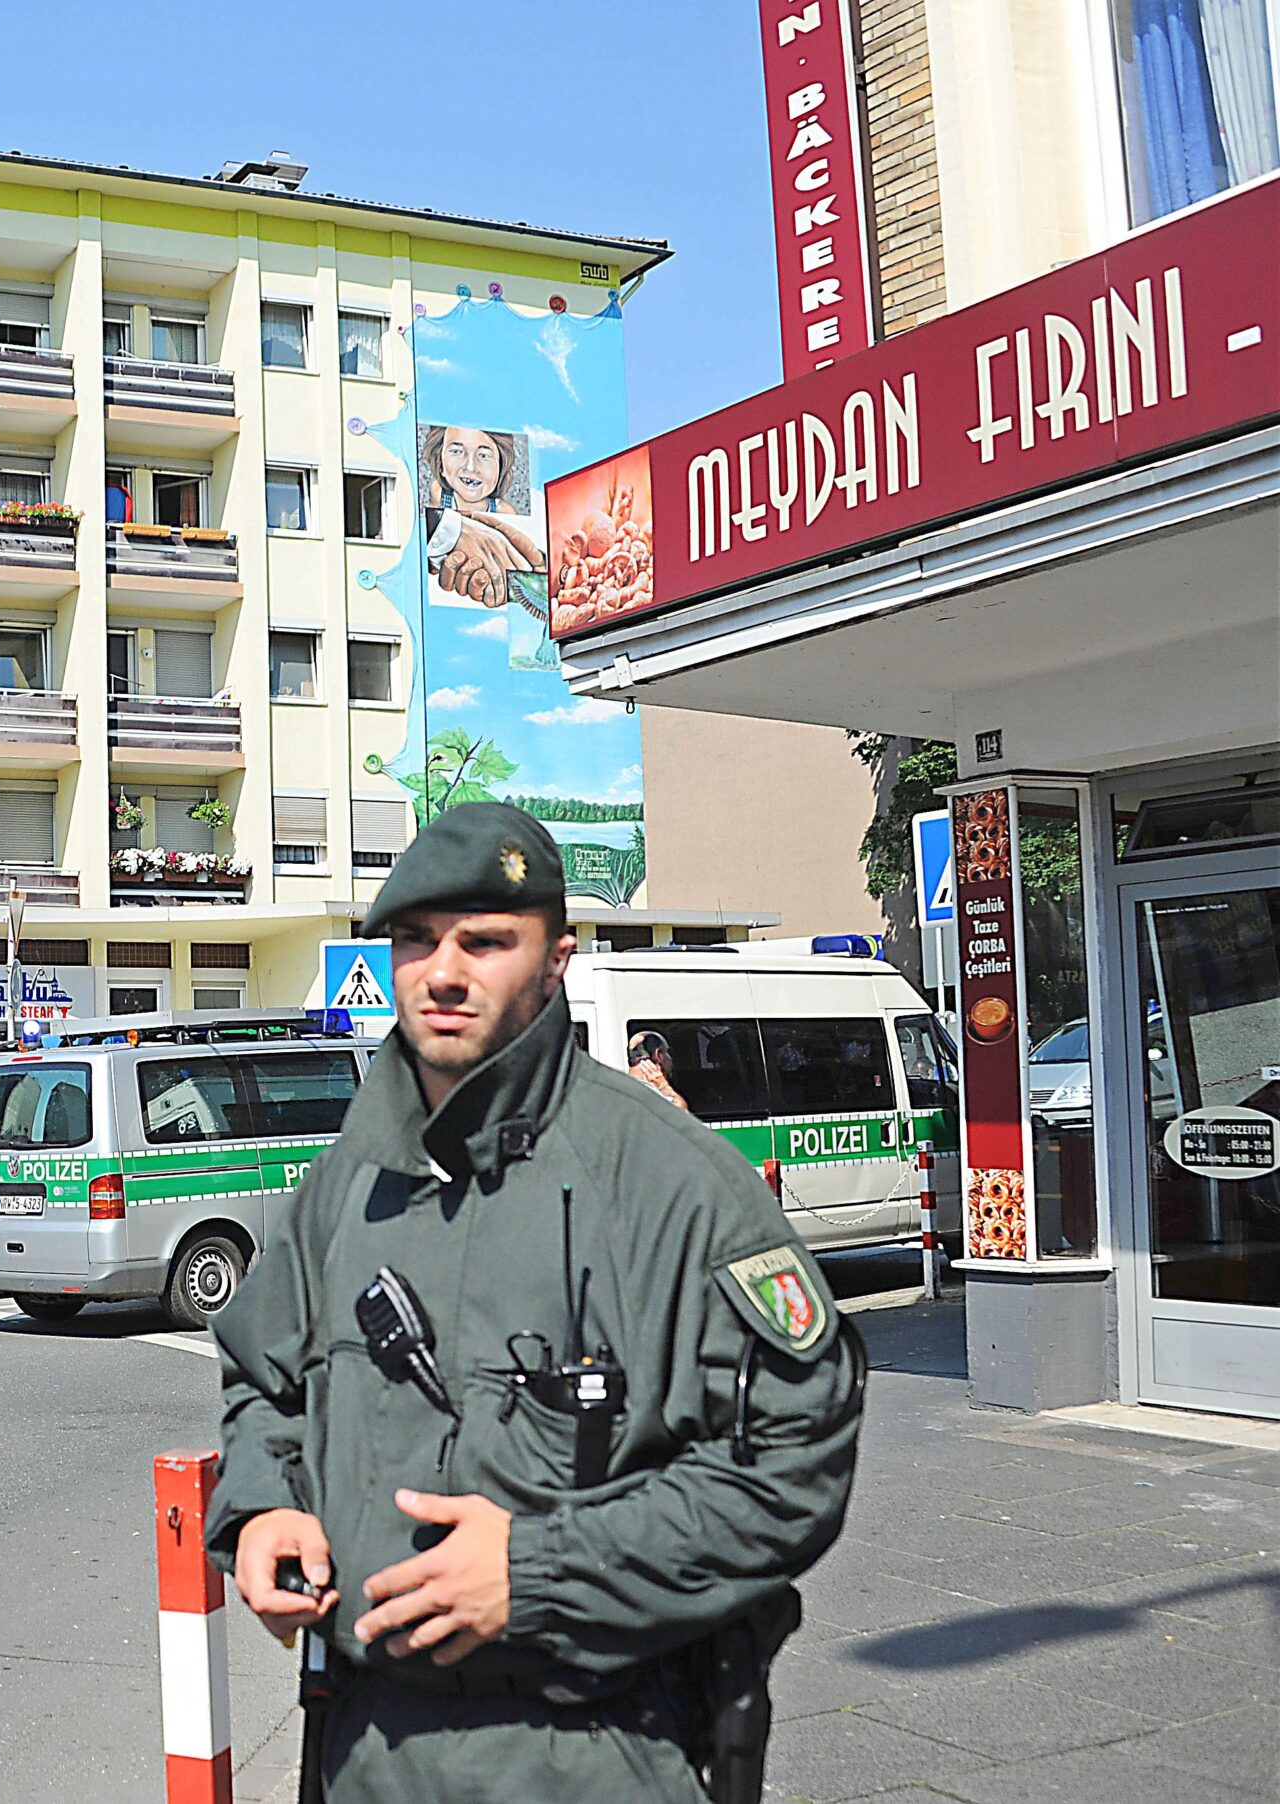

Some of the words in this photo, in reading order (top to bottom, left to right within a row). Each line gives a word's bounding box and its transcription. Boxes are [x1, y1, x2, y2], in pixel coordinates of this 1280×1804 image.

[778, 0, 822, 47] N
[786, 82, 844, 371] BÄCKERE
[688, 372, 920, 563] MEYDAN
[966, 266, 1188, 464] FIRINI
[965, 896, 1006, 916] Günlük
[972, 920, 1000, 935] Taze
[968, 938, 1007, 959] ÇORBA
[965, 956, 1012, 980] Çeşitleri
[20, 1005, 54, 1019] STEAK
[1184, 1121, 1270, 1135] ÖFFNUNGSZEITEN
[789, 1124, 868, 1158] POLIZEI
[23, 1161, 89, 1182] POLIZEI
